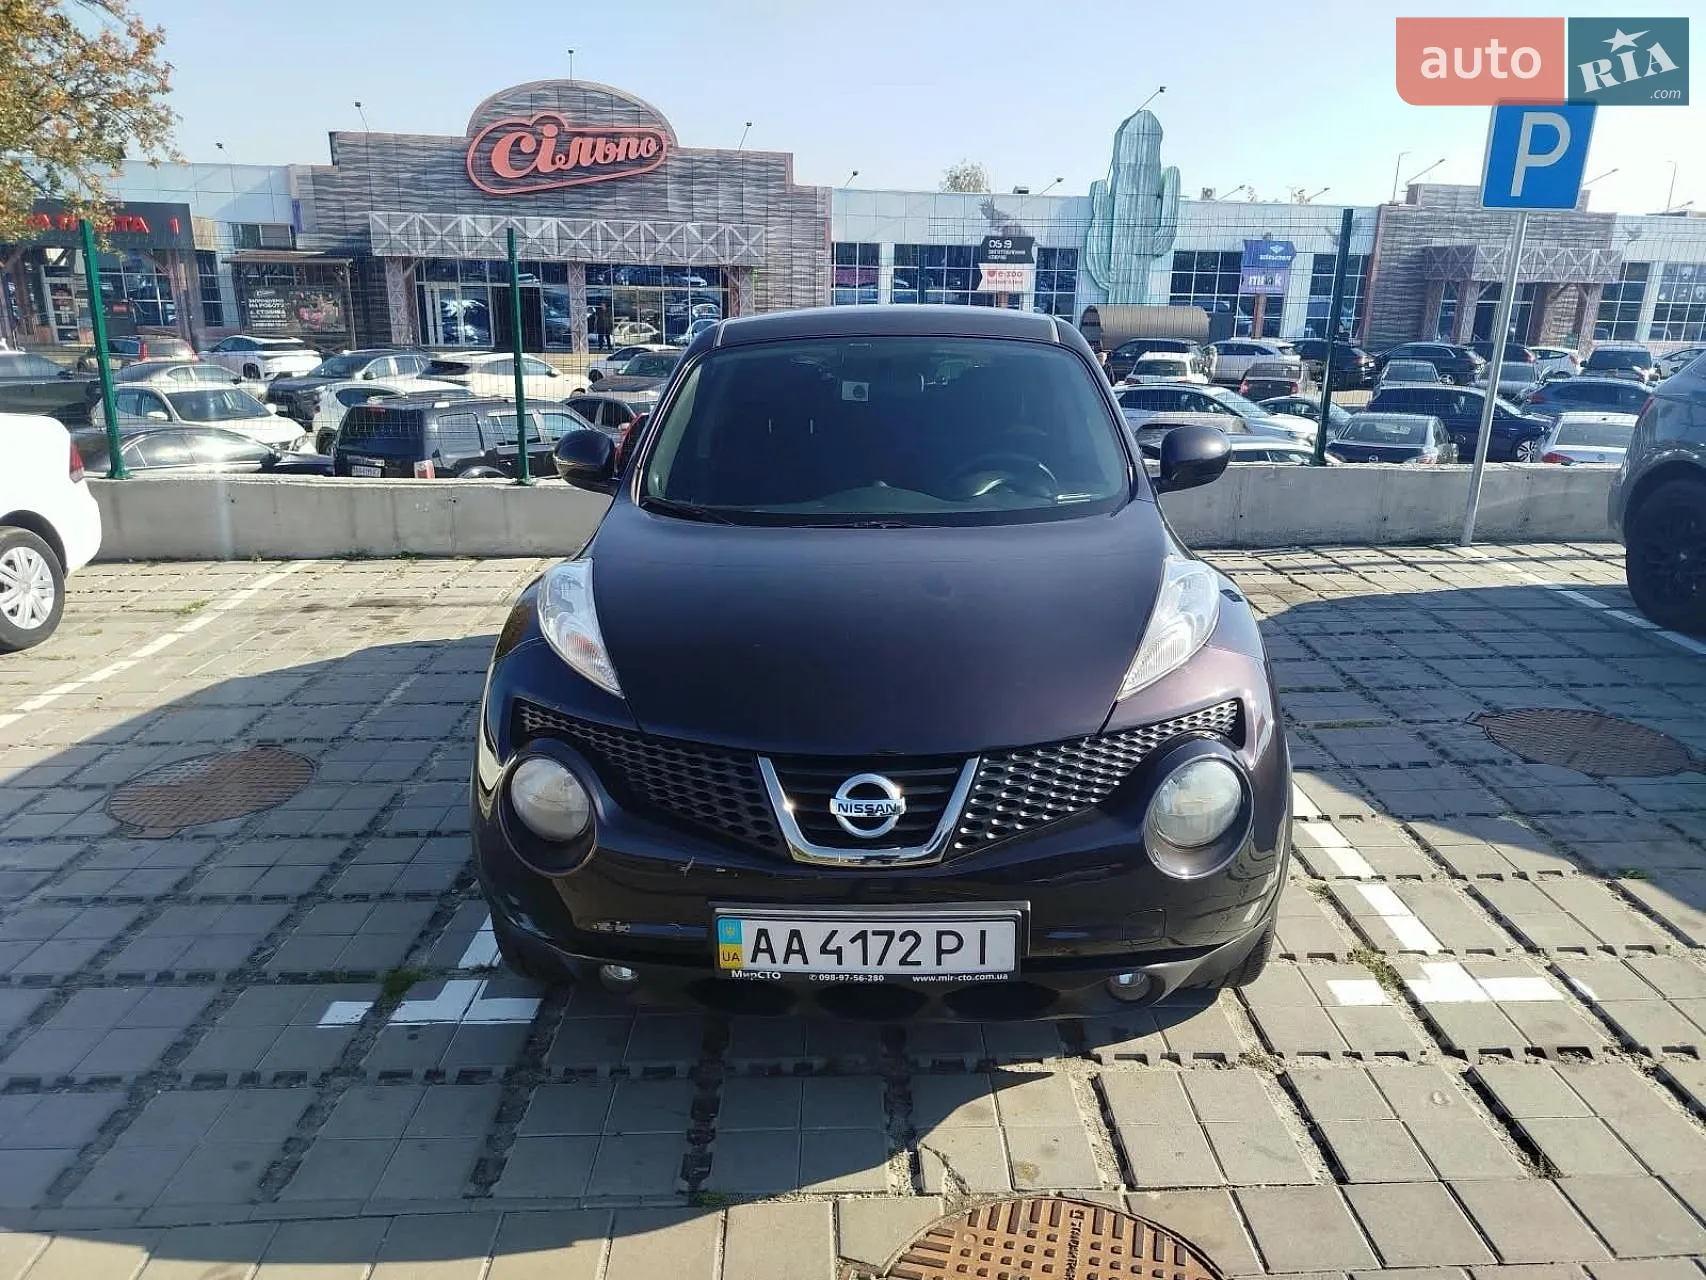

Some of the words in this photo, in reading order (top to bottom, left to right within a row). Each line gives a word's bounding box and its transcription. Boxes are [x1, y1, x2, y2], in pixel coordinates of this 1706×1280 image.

[491, 123, 659, 179] Сільпо
[1510, 111, 1571, 197] P
[837, 802, 897, 814] NISSAN
[722, 952, 740, 963] UA
[731, 970, 781, 981] МирСТО
[912, 973, 1008, 982] www.mir-cto.com.ua
